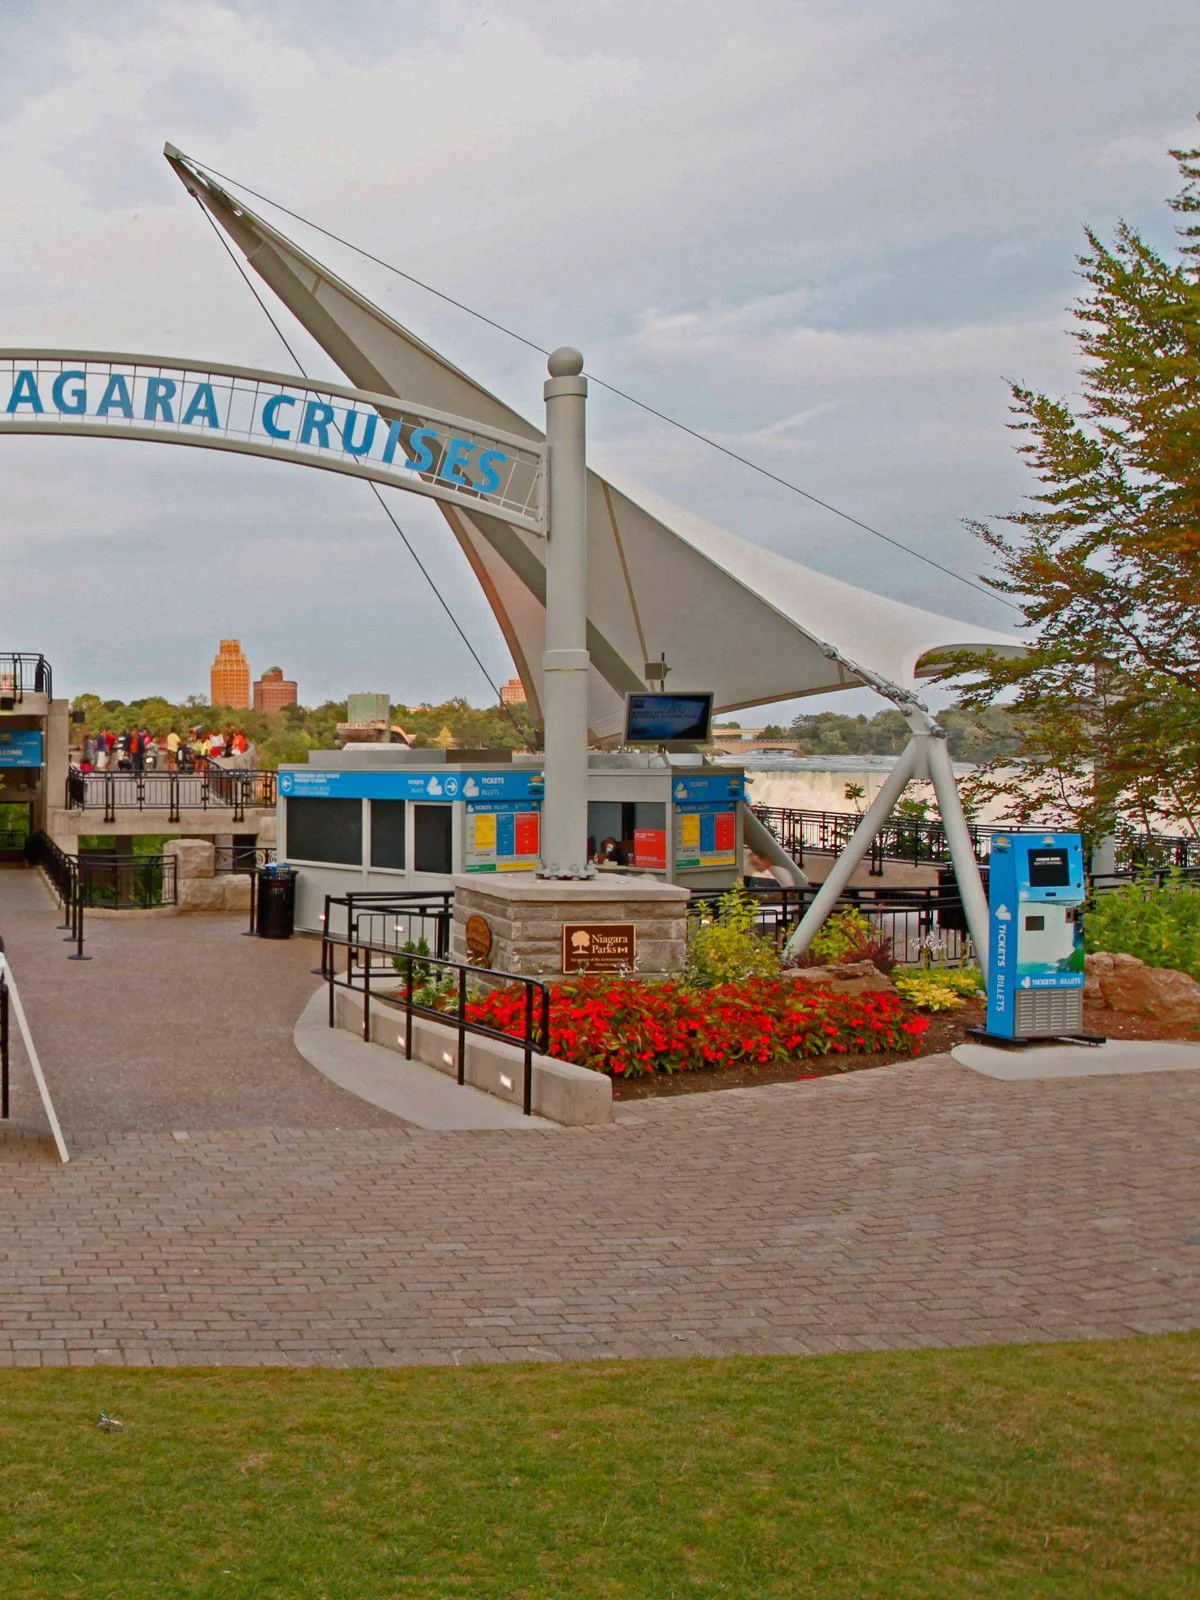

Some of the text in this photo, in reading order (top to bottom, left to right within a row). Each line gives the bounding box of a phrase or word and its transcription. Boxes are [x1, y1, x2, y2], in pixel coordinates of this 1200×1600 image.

[262, 394, 508, 494] CRUISES
[481, 777, 505, 785] TICKETS
[591, 934, 628, 946] Niagara
[592, 943, 617, 954] Parks
[996, 923, 1007, 1012] TICKETS BILLETS
